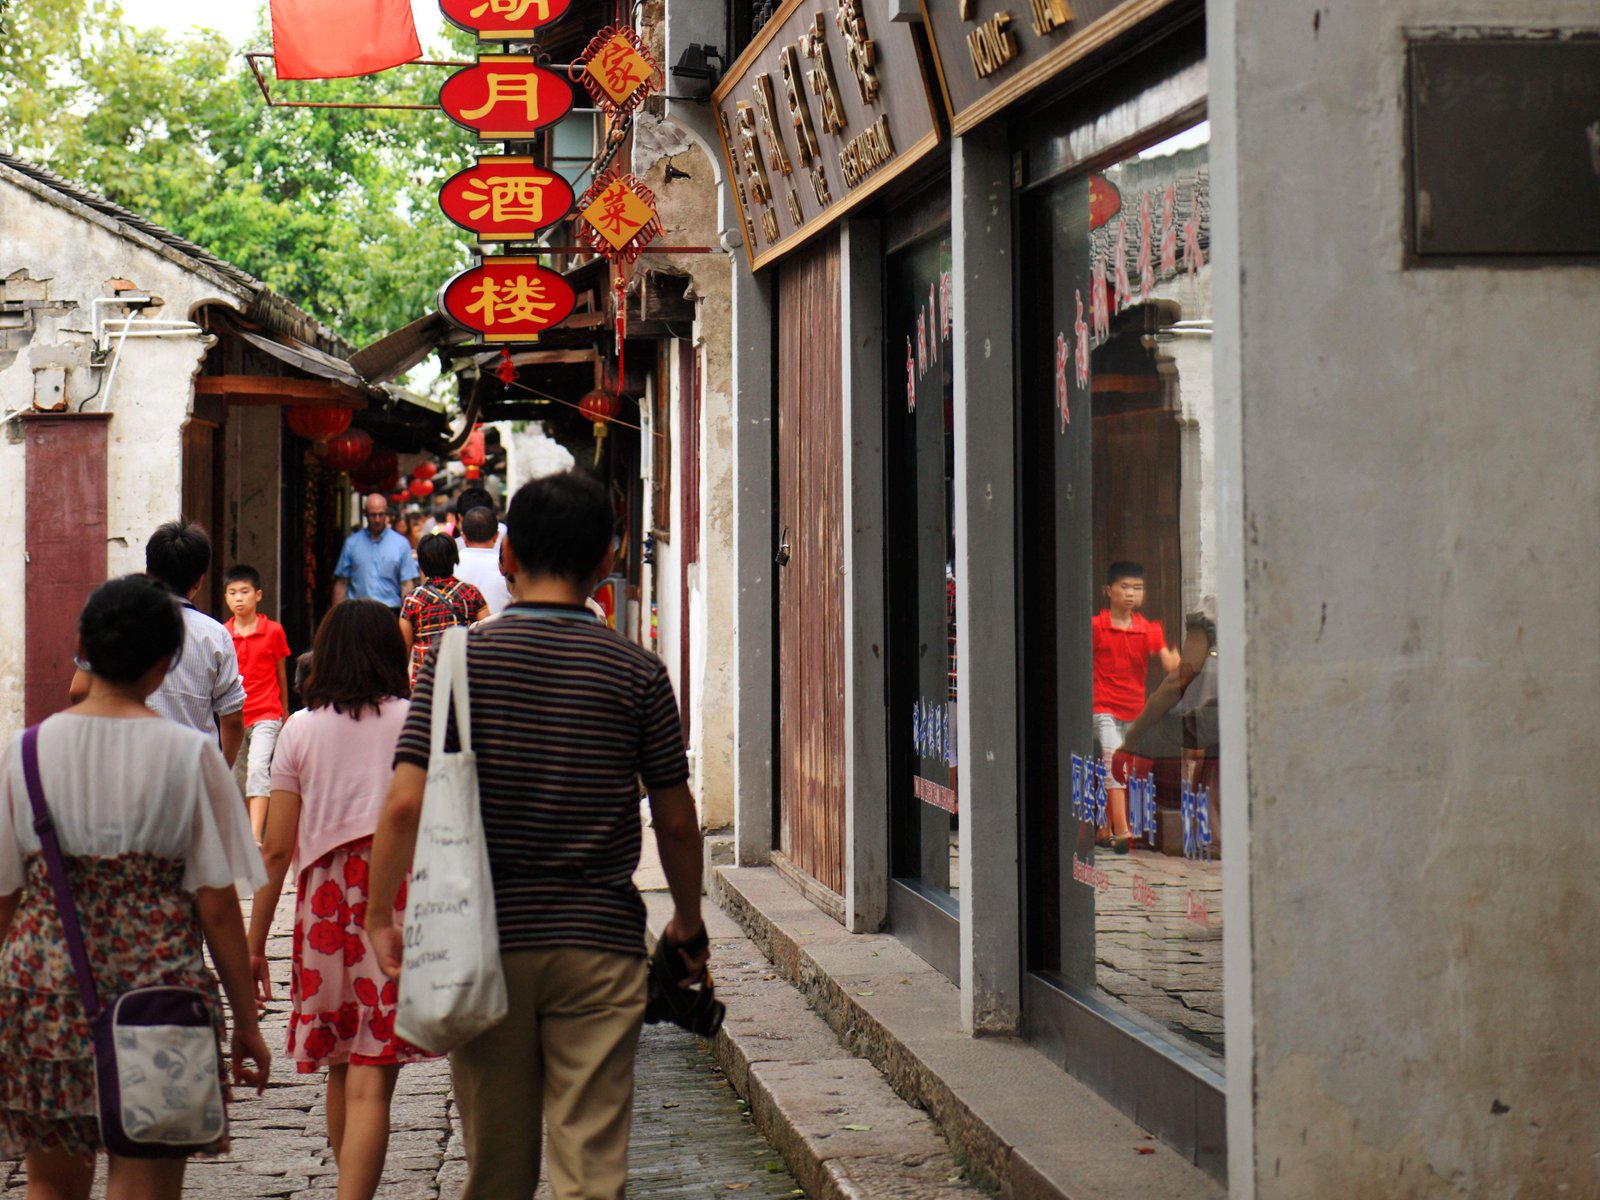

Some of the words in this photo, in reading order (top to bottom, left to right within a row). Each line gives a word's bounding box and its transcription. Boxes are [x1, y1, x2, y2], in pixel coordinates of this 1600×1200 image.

[966, 11, 1018, 81] NONG
[1070, 753, 1108, 830] 阿婆茶
[1128, 767, 1157, 846] 咖啡
